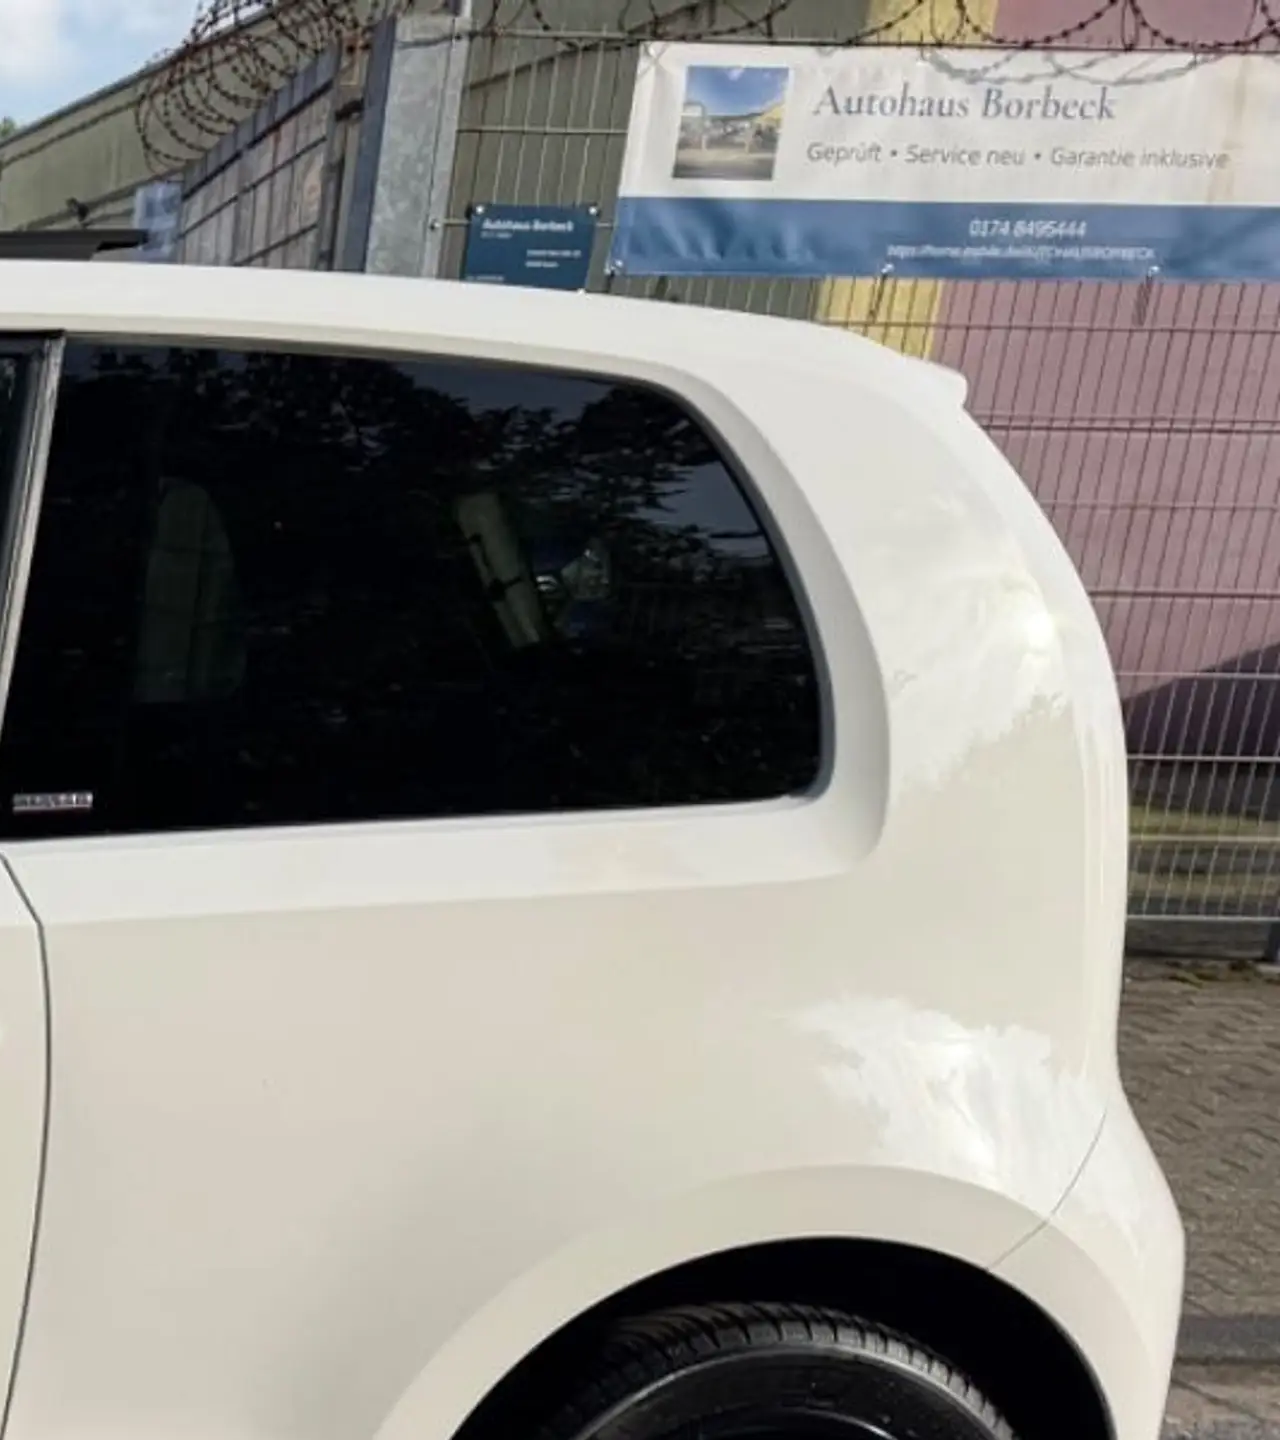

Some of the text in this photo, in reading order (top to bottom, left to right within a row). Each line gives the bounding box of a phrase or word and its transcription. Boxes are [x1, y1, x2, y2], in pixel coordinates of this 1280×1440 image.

[811, 81, 1117, 120] Autohaus Borbeck
[806, 142, 1231, 169] Geprüft Service neu Garantie inklusive
